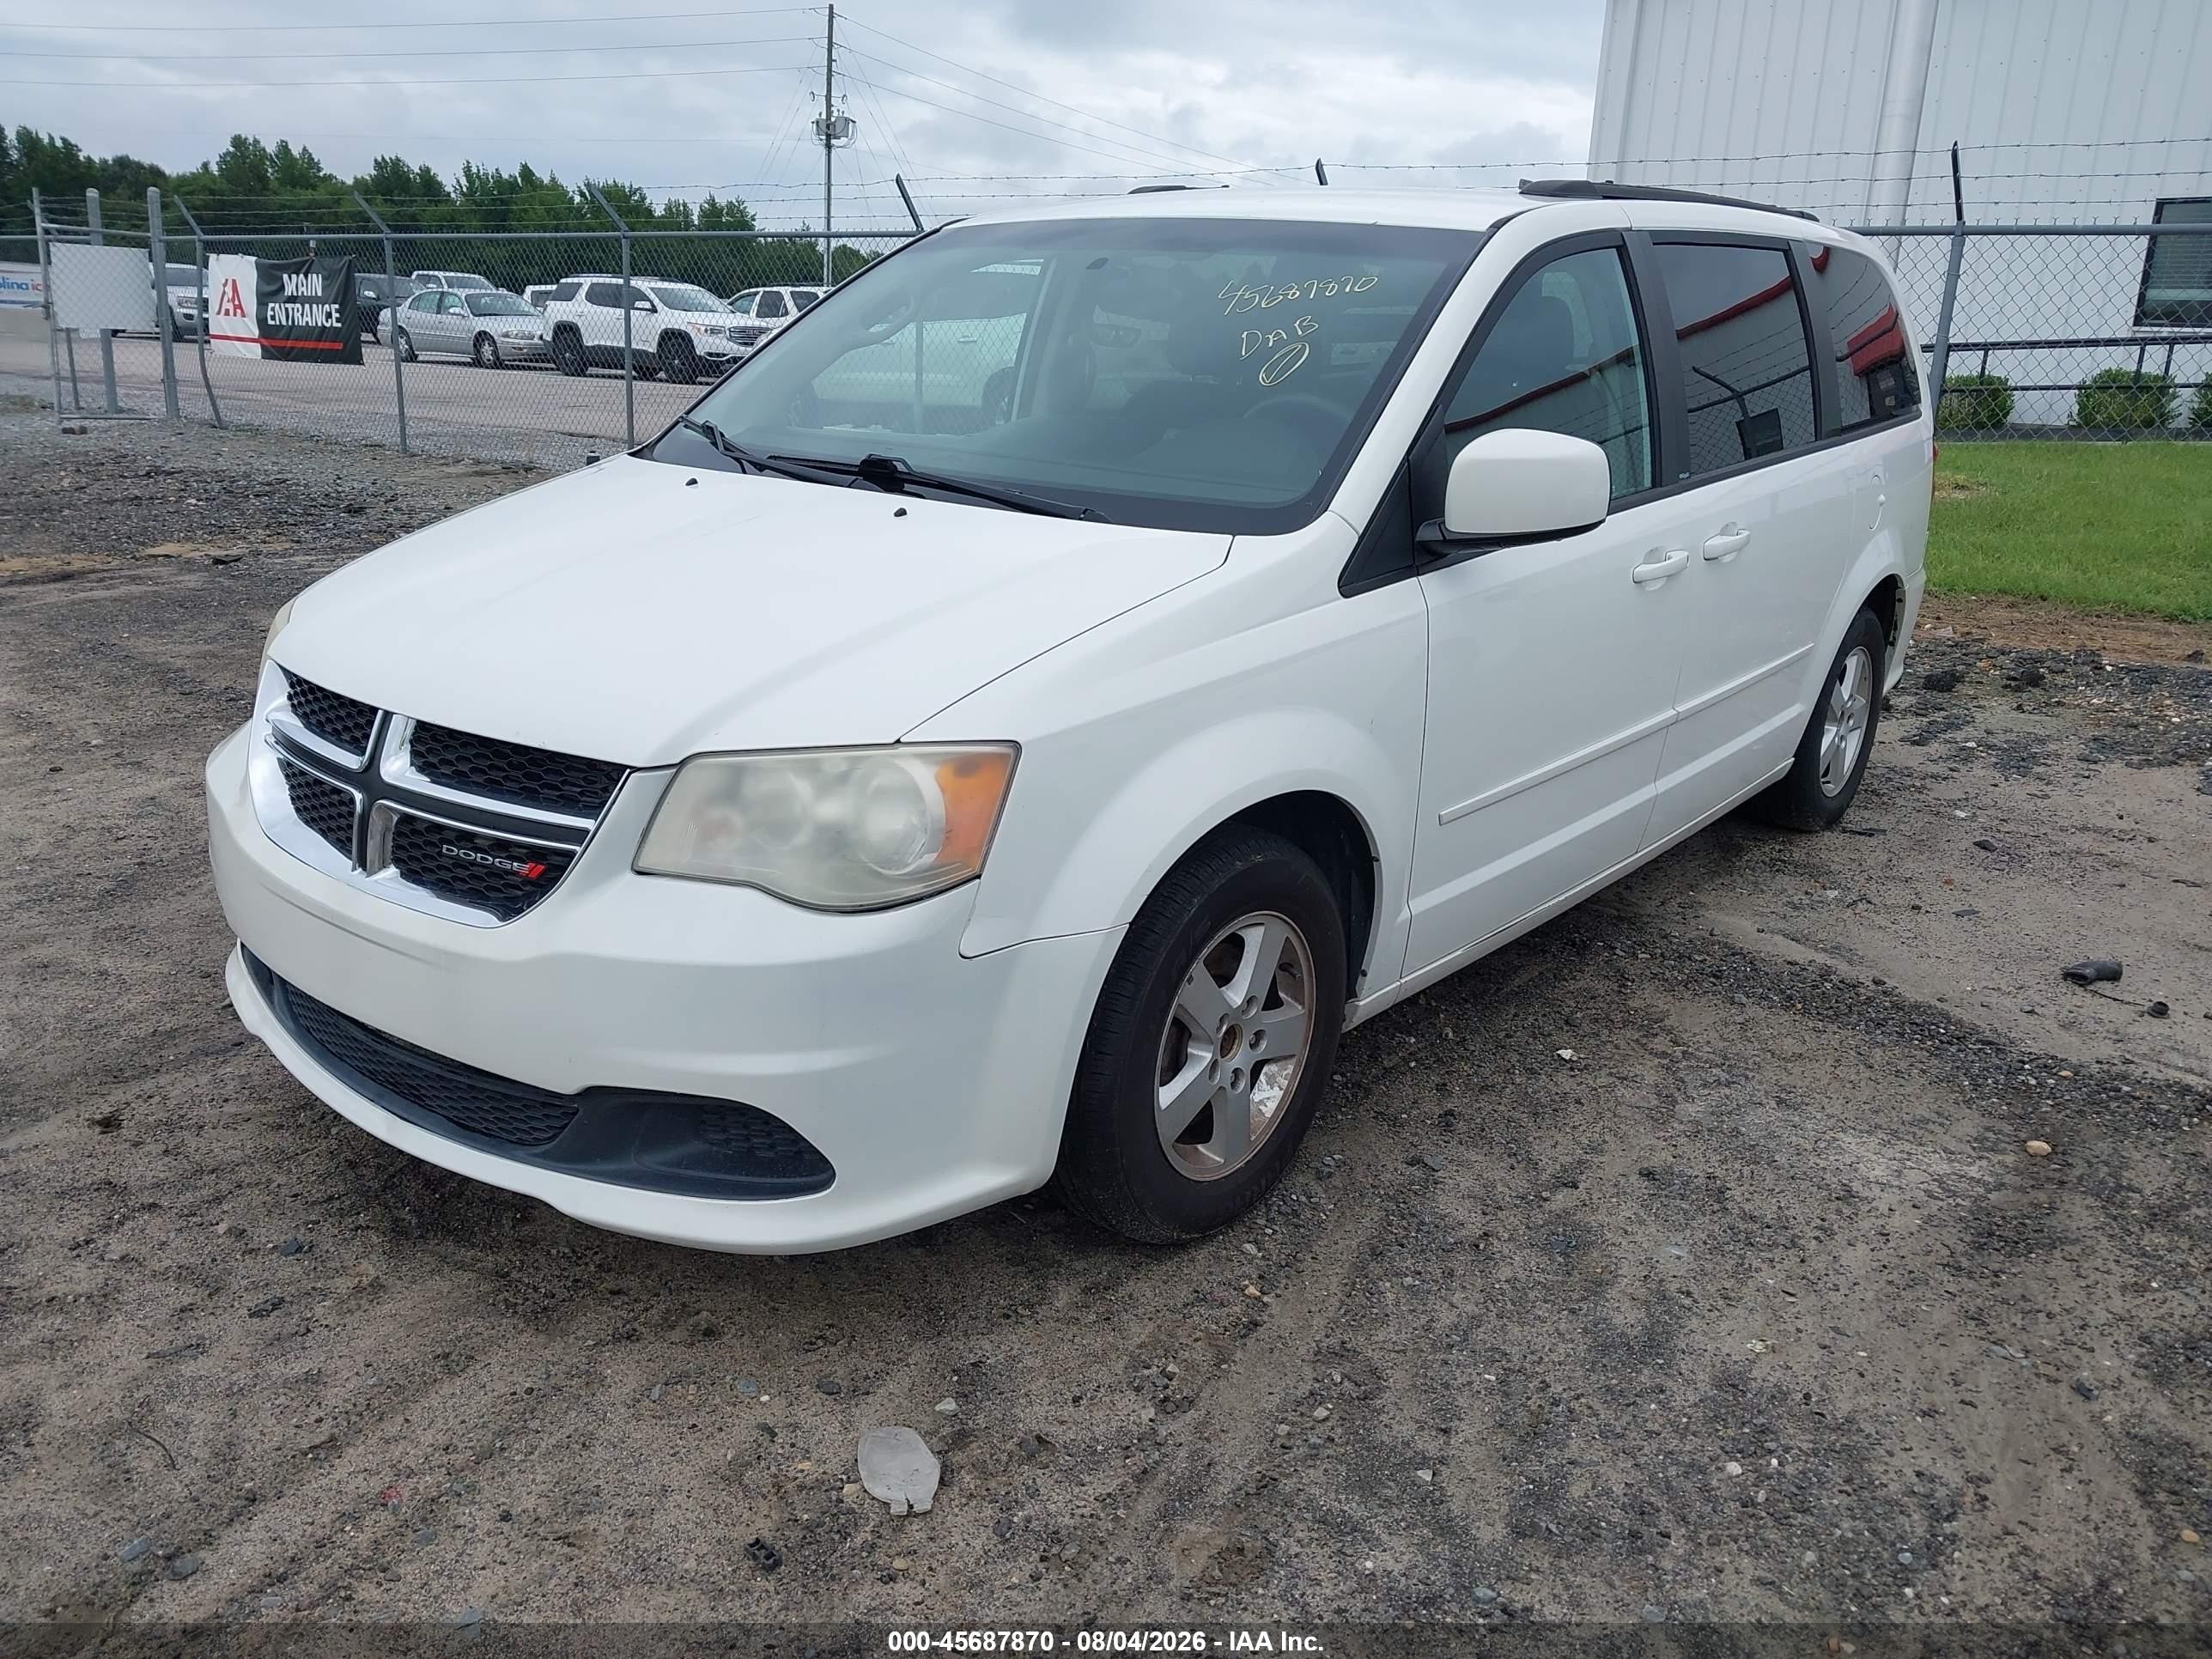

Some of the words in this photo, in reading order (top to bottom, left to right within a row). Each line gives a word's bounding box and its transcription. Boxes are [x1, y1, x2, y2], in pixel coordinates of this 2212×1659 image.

[283, 273, 322, 296] MAIN
[1218, 276, 1378, 315] 45687870
[267, 302, 342, 327] ENTRANCE
[441, 844, 530, 874] DODGE
